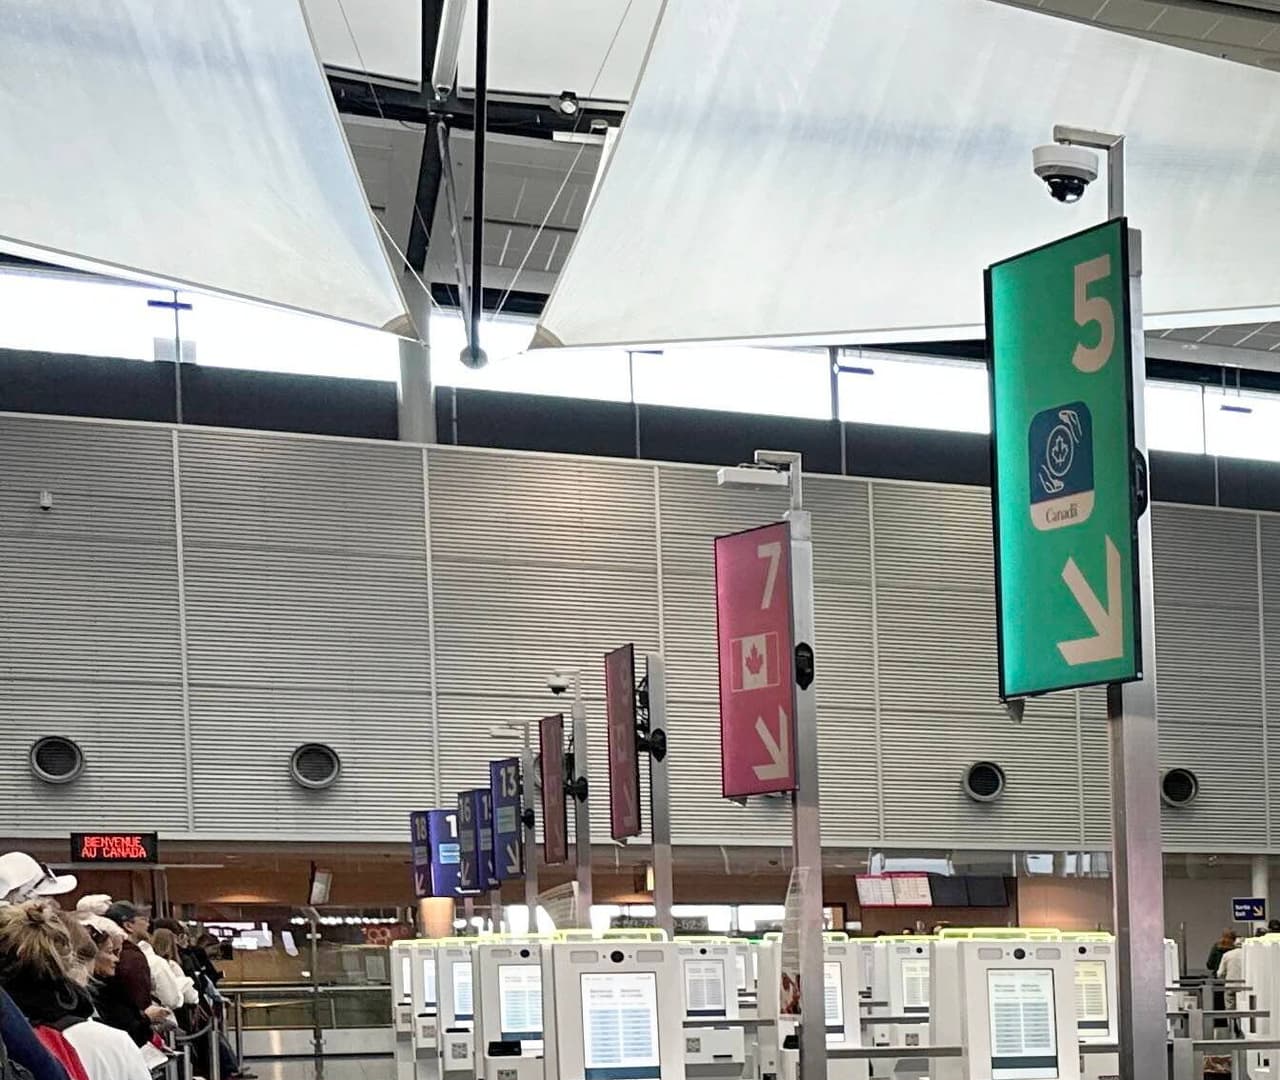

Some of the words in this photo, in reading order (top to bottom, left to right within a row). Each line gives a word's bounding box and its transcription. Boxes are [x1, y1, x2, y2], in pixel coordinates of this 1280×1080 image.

[1071, 254, 1115, 374] 5
[1045, 502, 1079, 524] Canada
[757, 541, 782, 610] 7
[500, 766, 518, 798] 13
[81, 847, 97, 858] AU
[103, 847, 147, 858] CANADA
[83, 836, 143, 848] BIENVENUE
